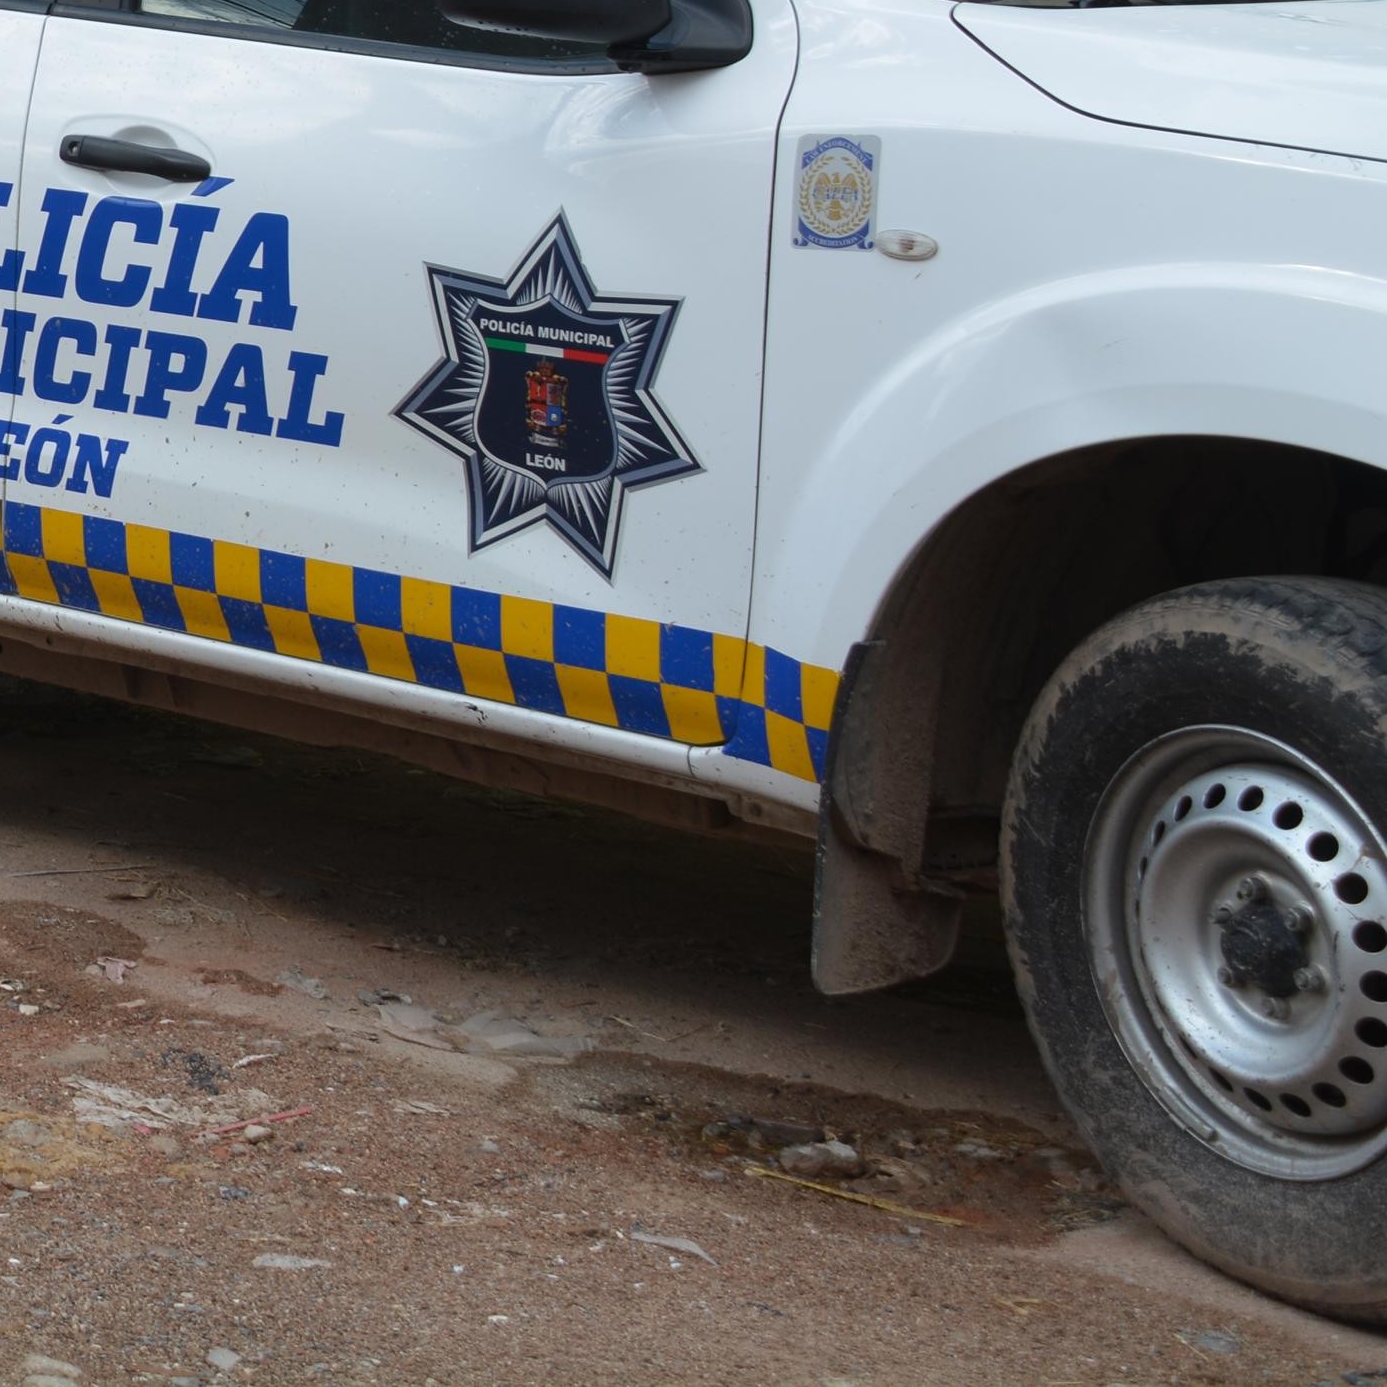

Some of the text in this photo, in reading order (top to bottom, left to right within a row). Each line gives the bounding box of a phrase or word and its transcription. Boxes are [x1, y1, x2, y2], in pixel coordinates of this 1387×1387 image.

[479, 317, 615, 348] POLICÍA MUNICIPAL
[525, 453, 566, 472] LEÓN
